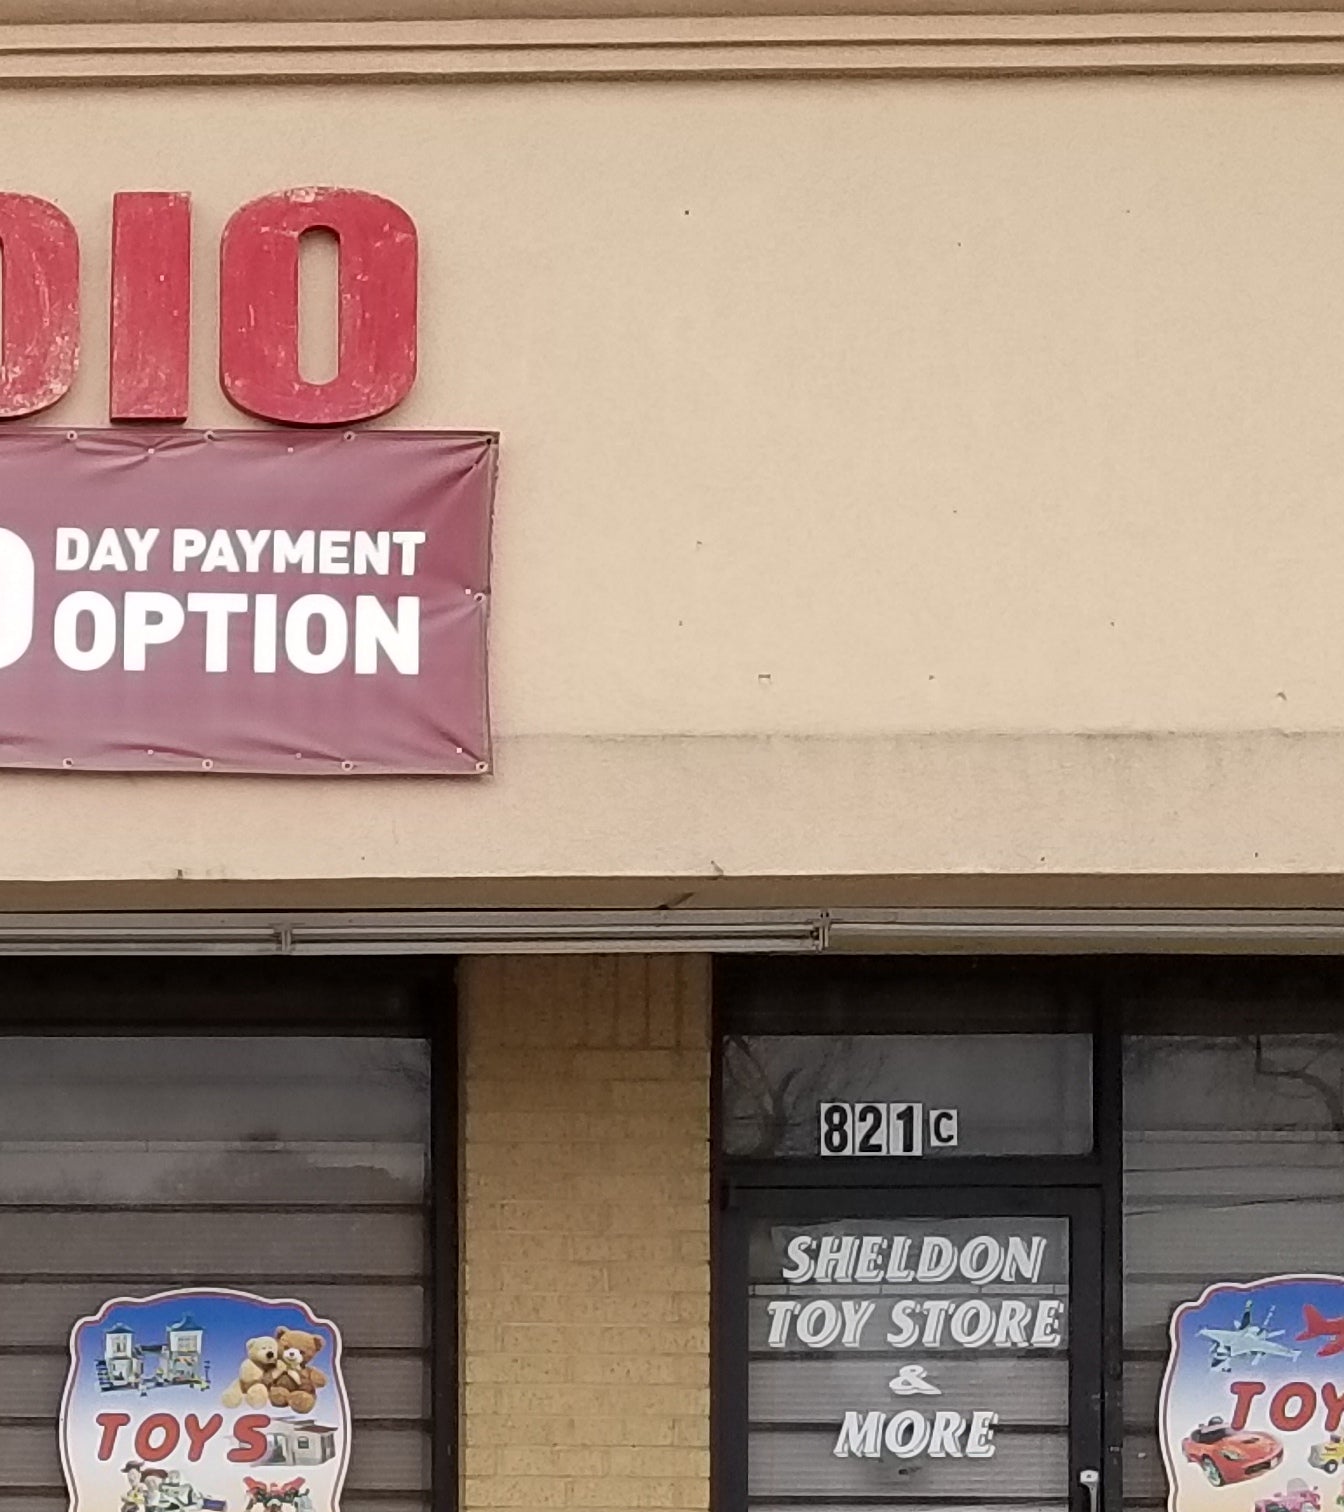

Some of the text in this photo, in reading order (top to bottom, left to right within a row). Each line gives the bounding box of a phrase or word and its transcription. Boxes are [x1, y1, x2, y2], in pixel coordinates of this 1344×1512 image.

[56, 527, 426, 576] DAY PAYMENT
[53, 590, 421, 675] OPTION
[823, 1103, 956, 1153] 821 C
[782, 1236, 1047, 1284] SHELDON
[767, 1300, 1064, 1347] TOY STORE
[889, 1365, 942, 1395] &
[1230, 1381, 1344, 1432] TOY
[96, 1412, 271, 1463] TOYS
[834, 1411, 998, 1457] MORE
